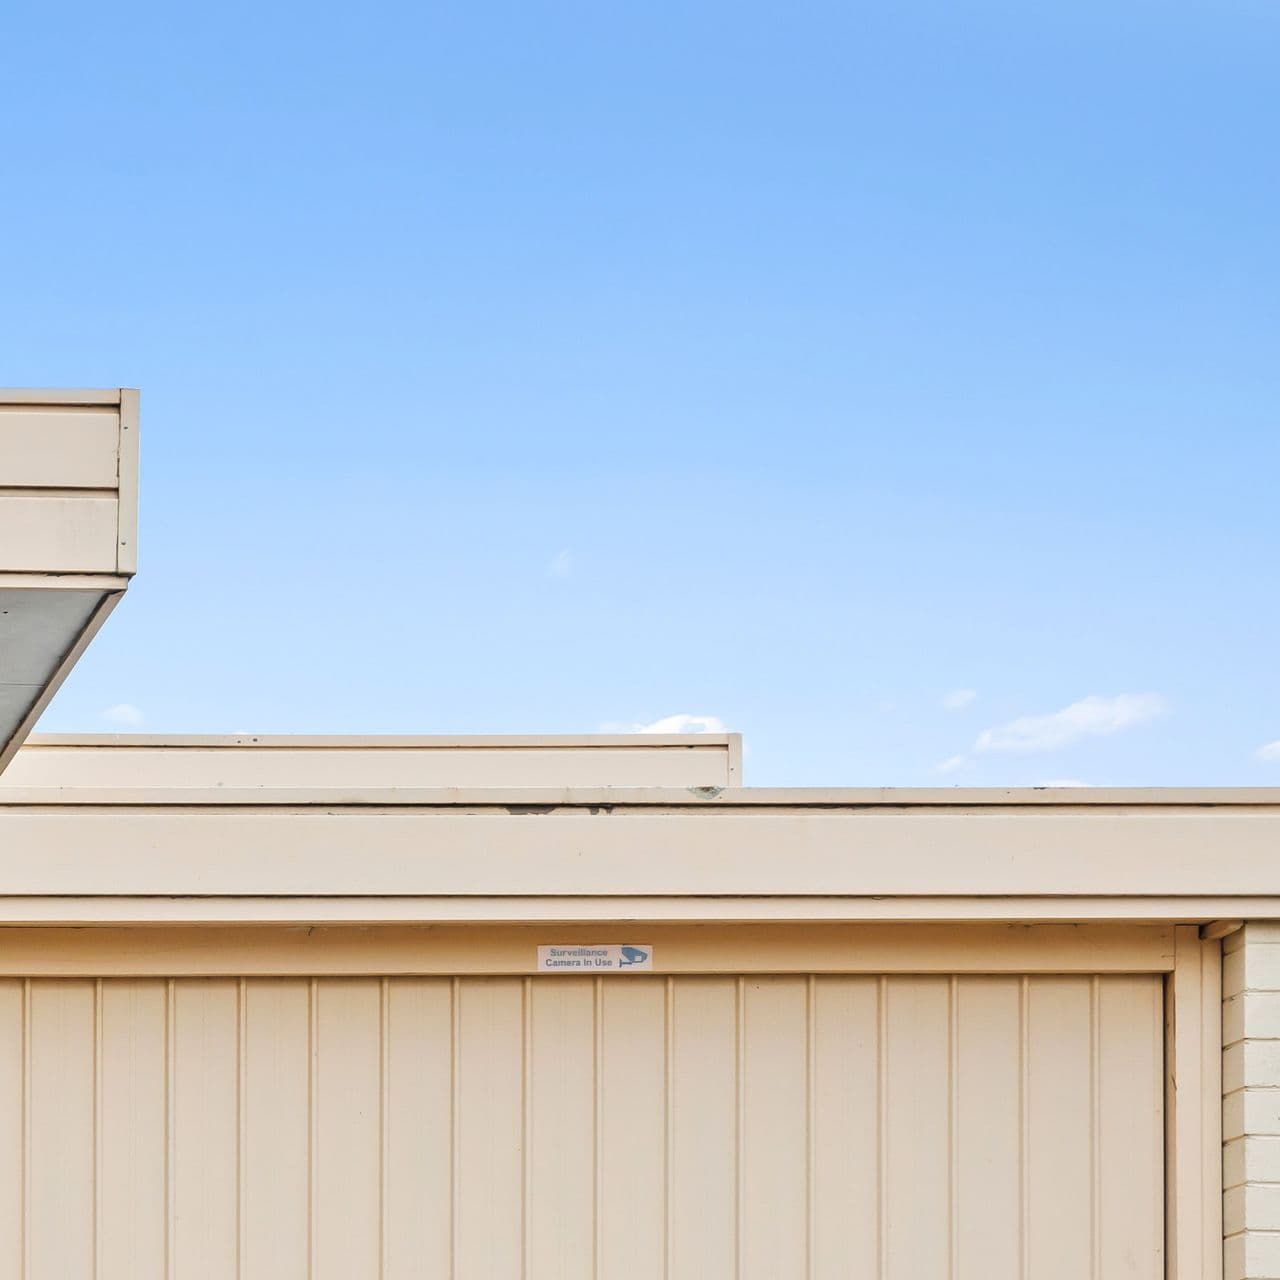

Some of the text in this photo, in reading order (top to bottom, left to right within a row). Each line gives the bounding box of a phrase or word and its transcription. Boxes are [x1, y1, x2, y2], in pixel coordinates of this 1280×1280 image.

[550, 948, 608, 957] Surveillance
[545, 958, 613, 967] Camera In Use
